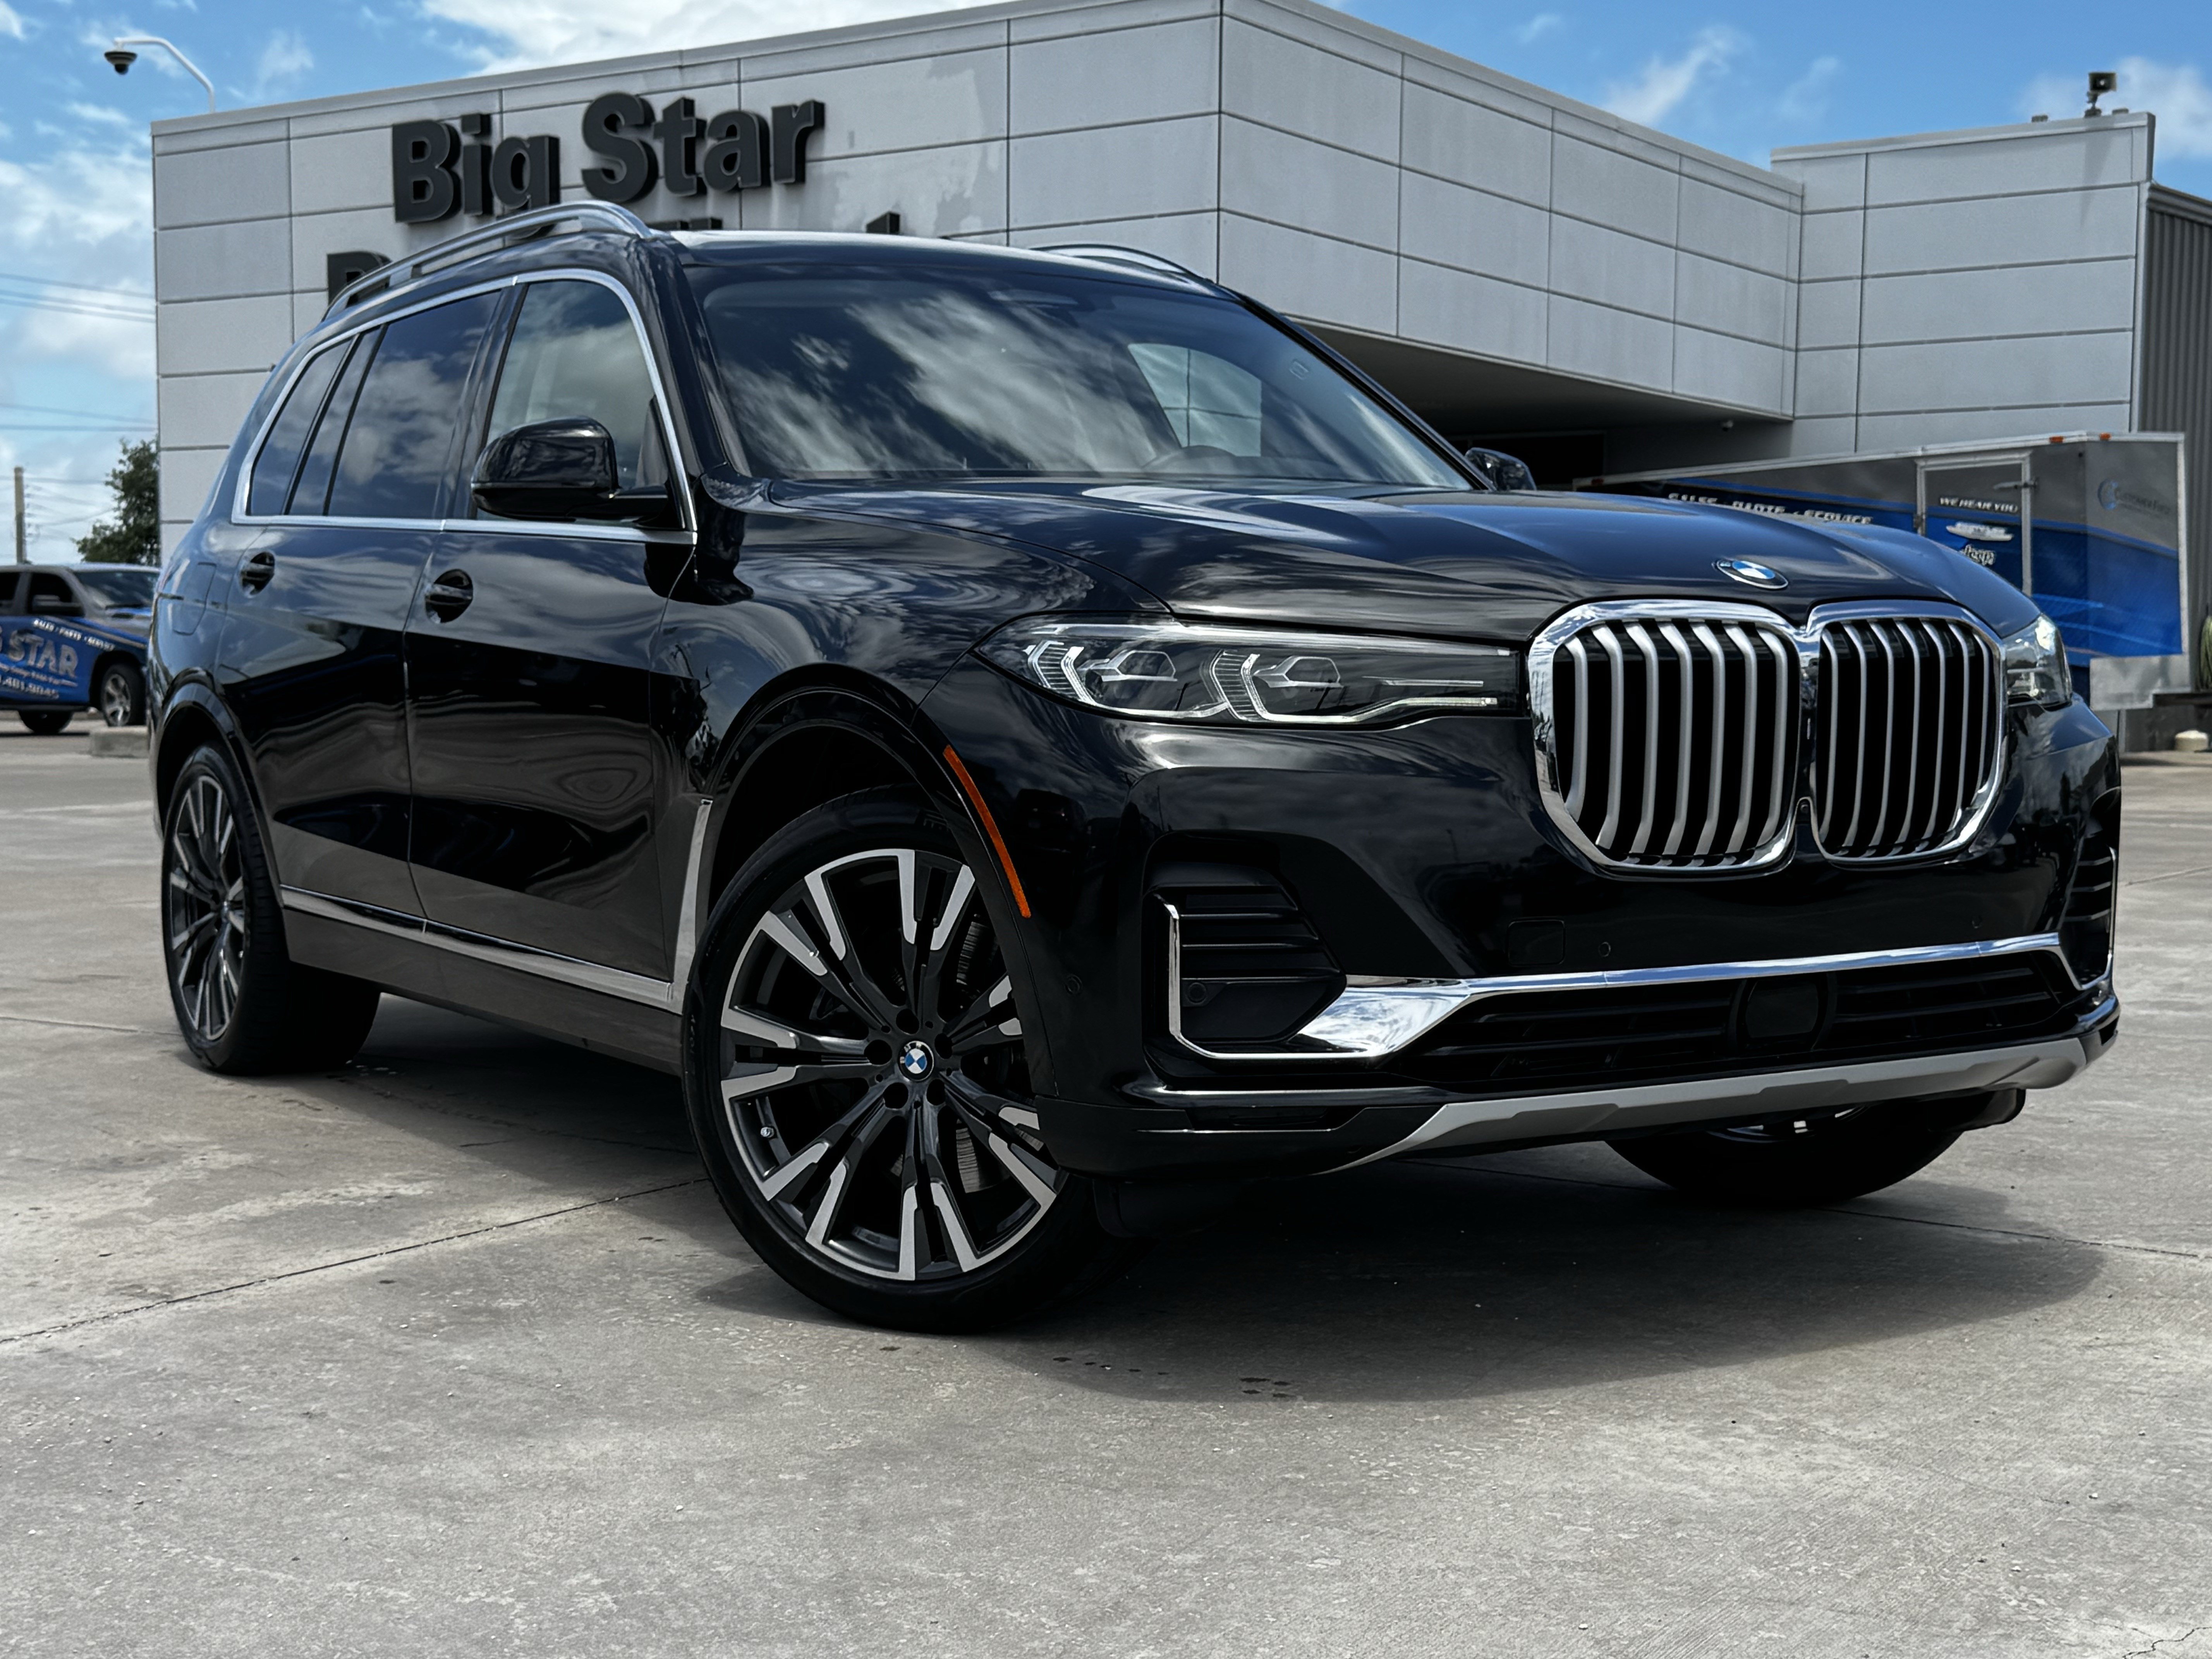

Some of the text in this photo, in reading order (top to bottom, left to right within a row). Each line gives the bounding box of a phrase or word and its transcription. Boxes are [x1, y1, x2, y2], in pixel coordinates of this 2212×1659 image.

[392, 92, 825, 238] Big Star
[8, 629, 77, 678] STAR
